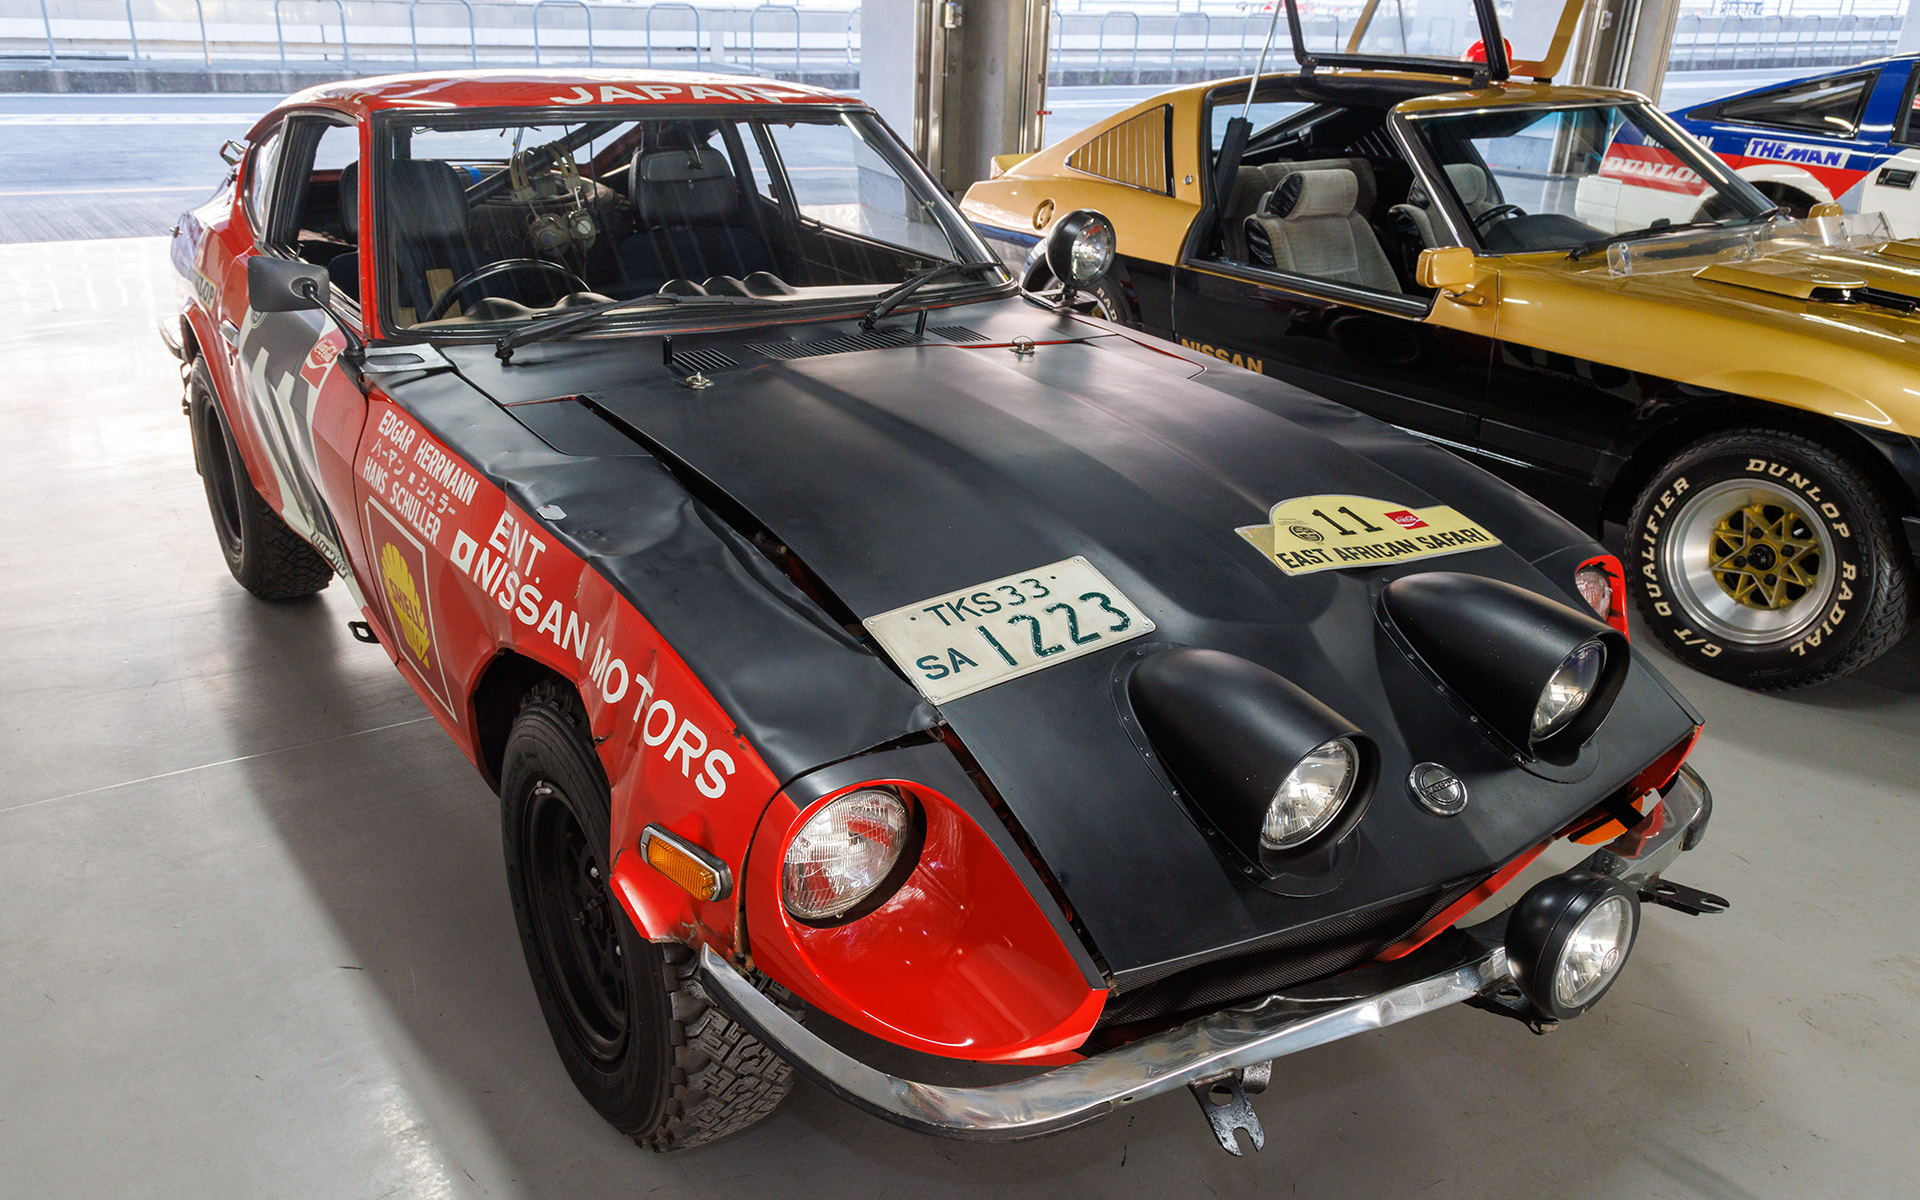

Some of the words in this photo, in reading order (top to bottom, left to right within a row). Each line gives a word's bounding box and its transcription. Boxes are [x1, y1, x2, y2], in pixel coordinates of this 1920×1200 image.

[550, 85, 783, 105] JAPAN
[377, 409, 416, 454] EDGAR
[413, 438, 480, 506] HERRMANN
[363, 456, 389, 495] HANS
[389, 481, 442, 546] SCHULLER
[1311, 506, 1384, 536] 11
[1746, 458, 1851, 539] DUNLOP
[488, 510, 547, 584] ENT.
[1275, 547, 1335, 570] EAST
[1332, 539, 1423, 563] AFRICAN
[1415, 527, 1490, 552] SAFARI
[1642, 476, 1691, 617] QUALIFIER
[388, 578, 425, 634] SHELL
[915, 647, 979, 681] SA
[975, 591, 1132, 669] 1223
[1674, 628, 1723, 658] G/T
[1790, 560, 1857, 657] RADIAL
[472, 547, 590, 661] NISSAN
[589, 637, 736, 799] MOTORS
